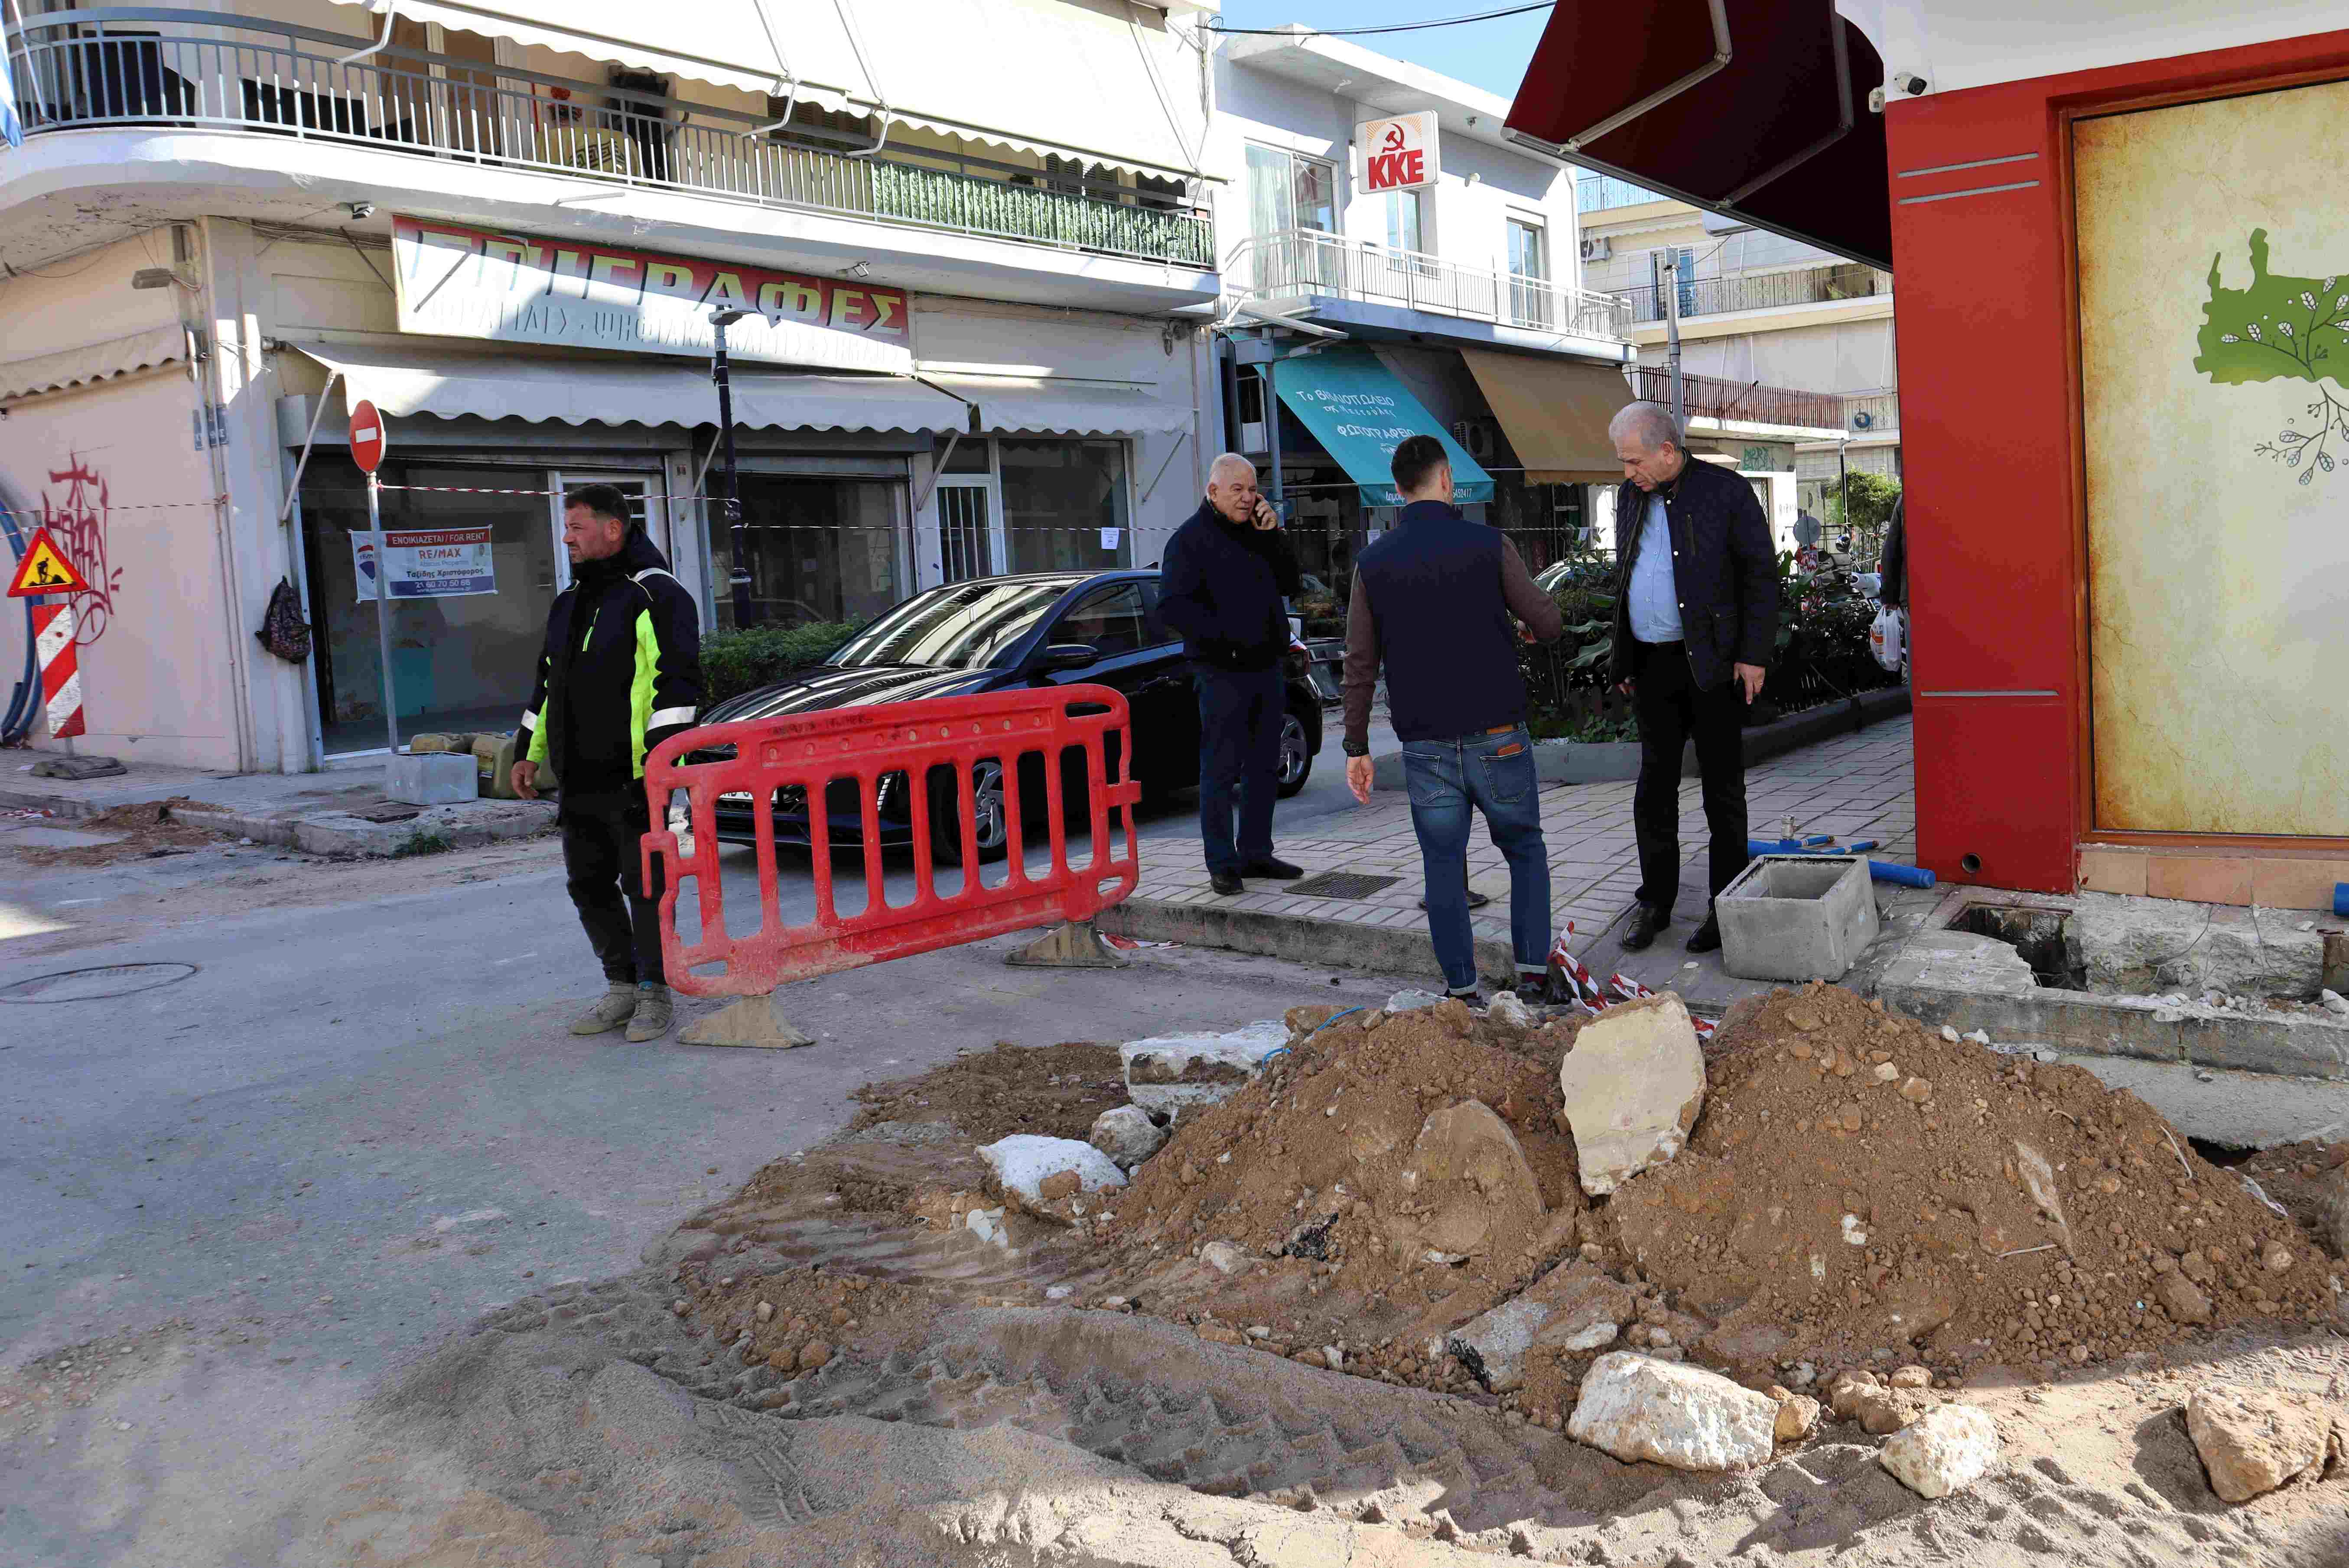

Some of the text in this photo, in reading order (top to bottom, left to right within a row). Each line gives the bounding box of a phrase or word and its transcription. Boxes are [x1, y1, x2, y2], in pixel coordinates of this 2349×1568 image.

[1368, 149, 1424, 189] ΚΚΕ
[392, 535, 444, 544] ΕΝΟΙΚΙΑΖΕΤΑΙ
[465, 532, 485, 541] RENT
[418, 548, 461, 559] RE/MAX
